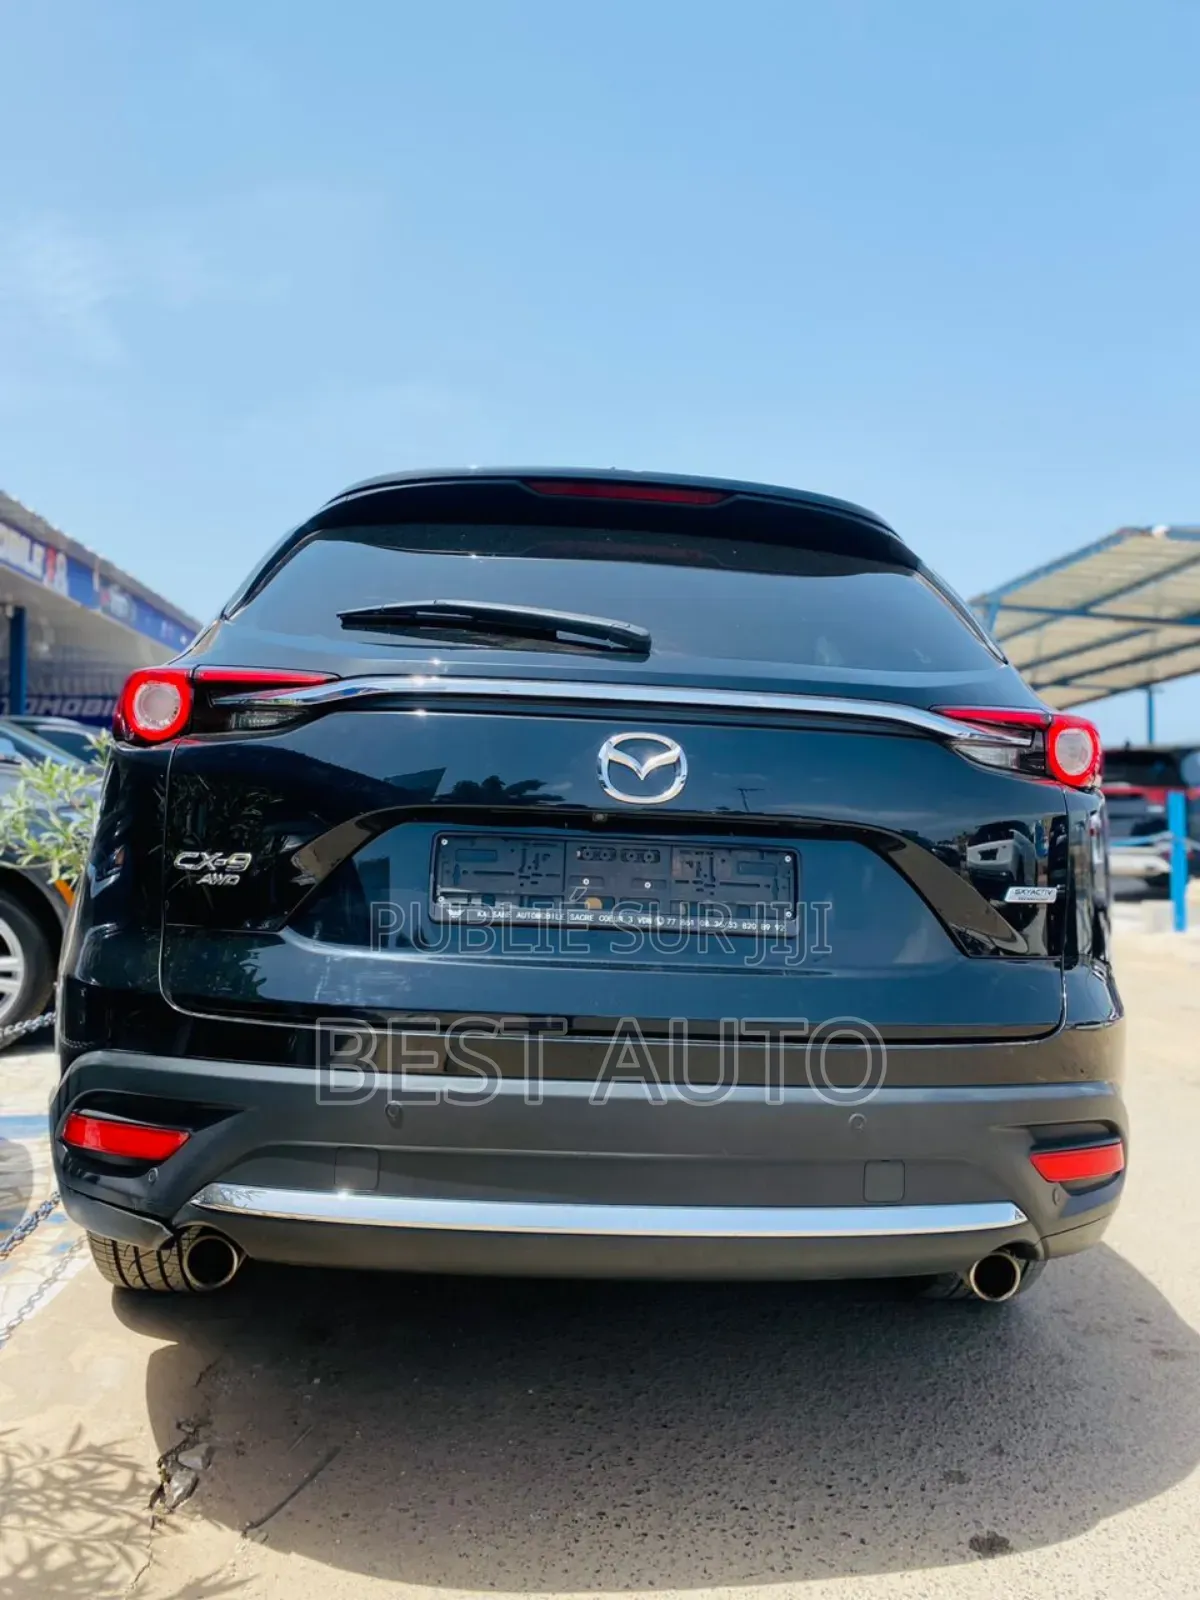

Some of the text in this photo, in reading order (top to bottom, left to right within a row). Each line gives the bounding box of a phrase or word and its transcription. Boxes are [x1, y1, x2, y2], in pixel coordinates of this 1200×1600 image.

[173, 851, 252, 871] CX-9
[196, 873, 240, 885] AWD
[516, 912, 566, 920] AUTOMOBILE
